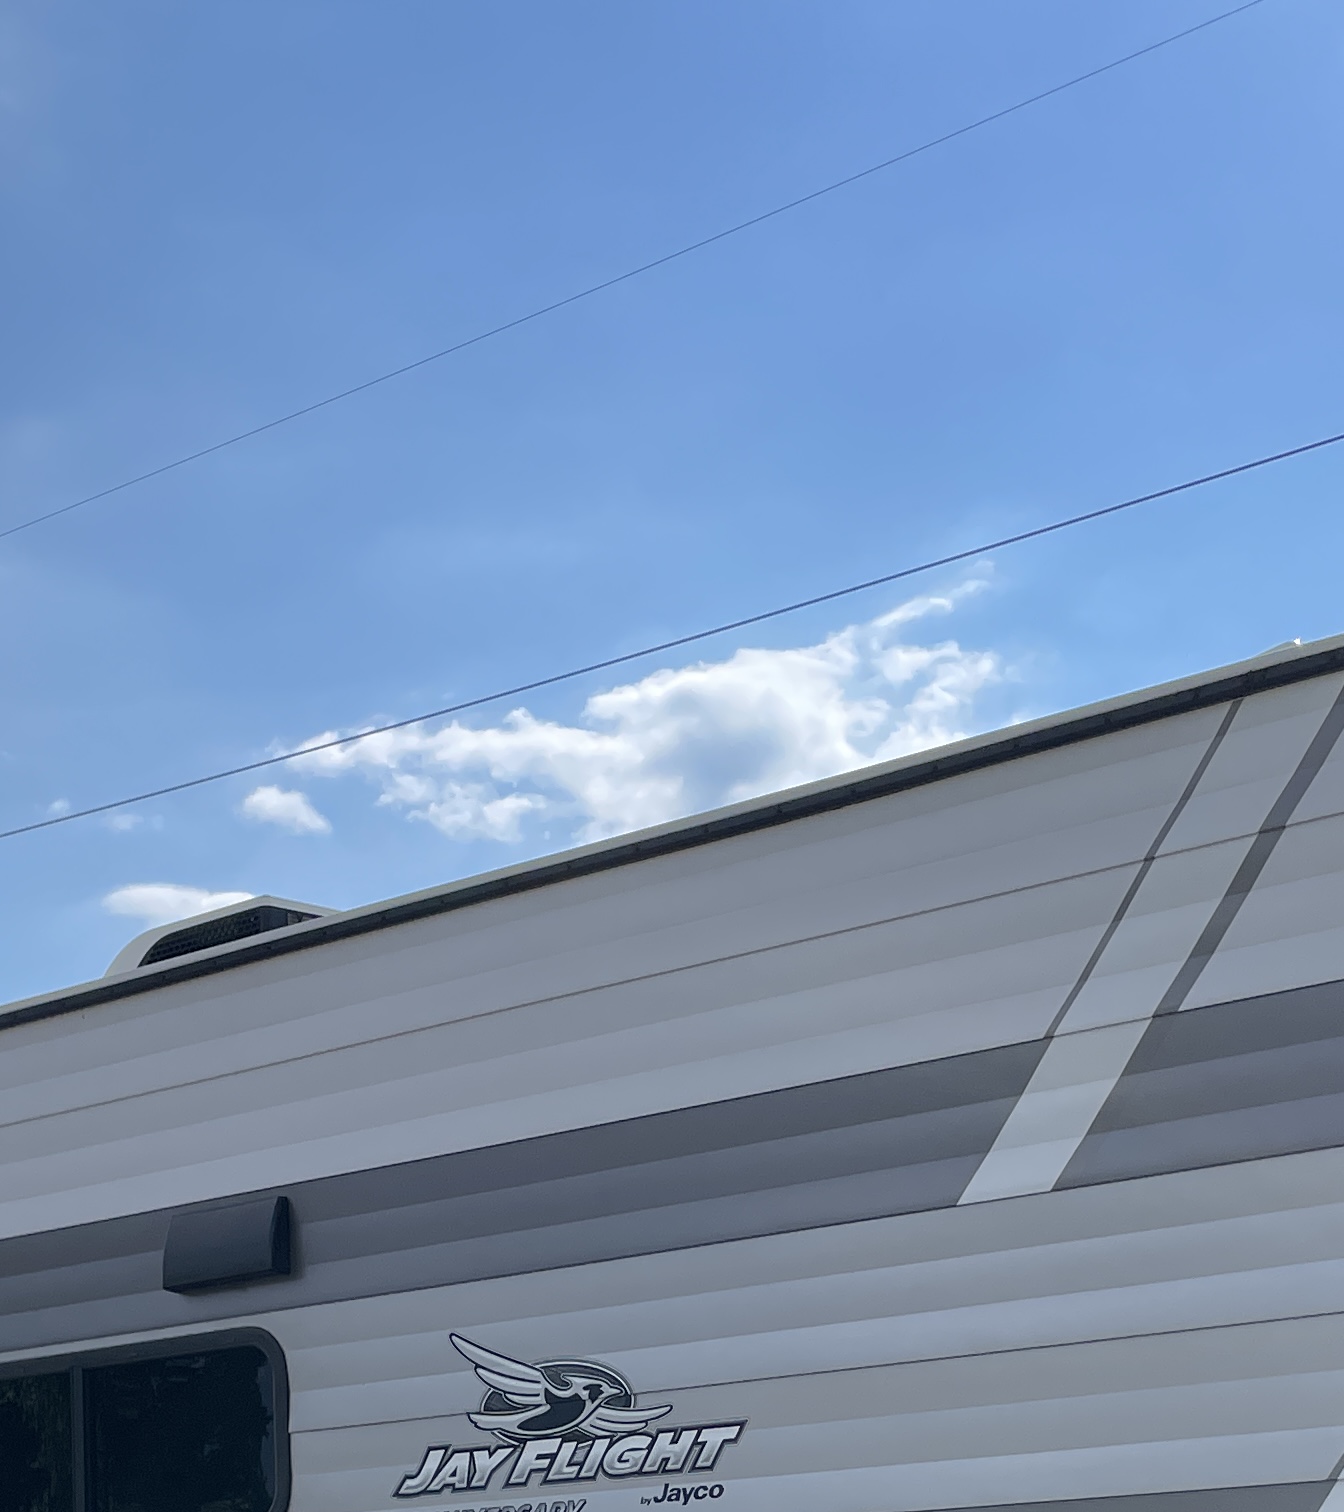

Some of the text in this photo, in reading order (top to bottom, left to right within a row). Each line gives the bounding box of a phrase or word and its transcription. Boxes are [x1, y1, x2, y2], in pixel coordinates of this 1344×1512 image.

[393, 1420, 748, 1498] JAY FLIGHT
[640, 1483, 725, 1506] by Jayco
